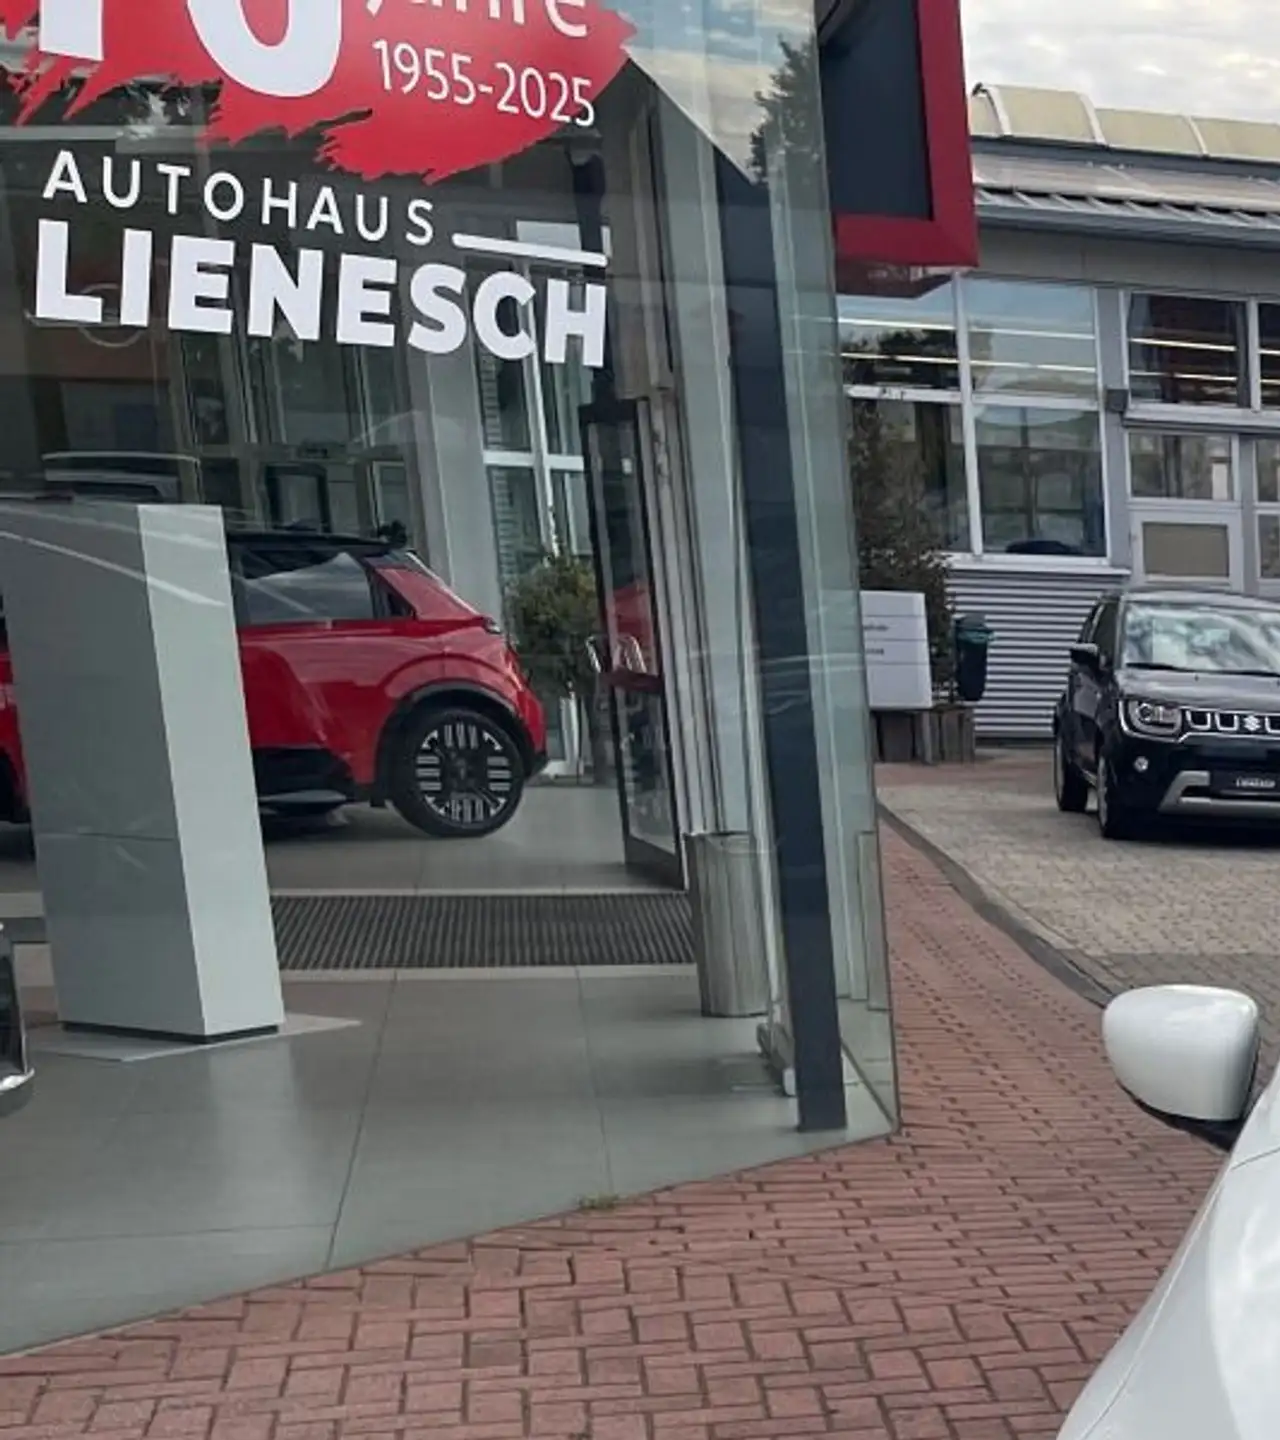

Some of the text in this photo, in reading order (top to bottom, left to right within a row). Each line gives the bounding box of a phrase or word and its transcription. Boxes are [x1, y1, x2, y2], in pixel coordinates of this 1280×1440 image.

[373, 39, 594, 127] 1955-2025
[43, 150, 434, 244] AUTOHAUS
[35, 219, 607, 367] LIENESCH
